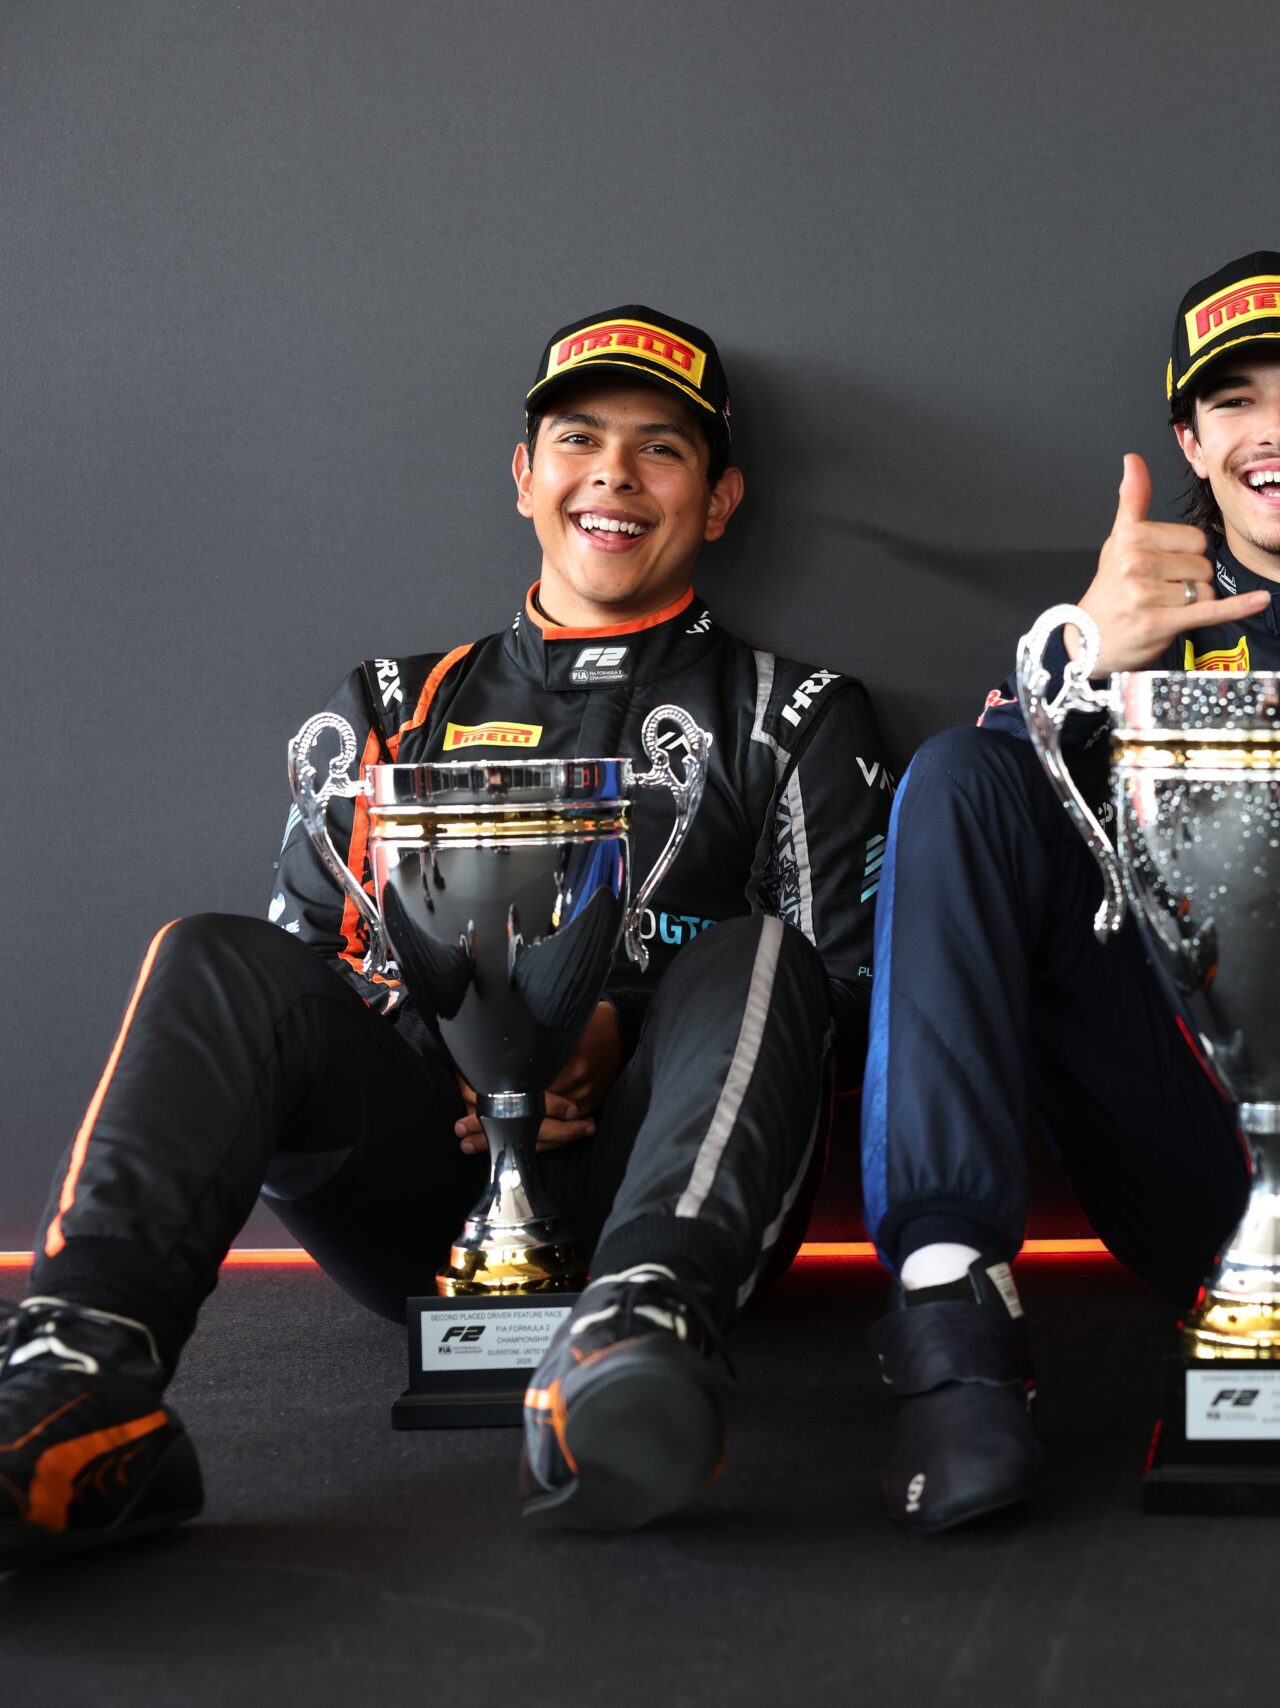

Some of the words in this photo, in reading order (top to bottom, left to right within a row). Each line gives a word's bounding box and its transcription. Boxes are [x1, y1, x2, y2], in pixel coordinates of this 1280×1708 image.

[557, 324, 695, 372] PIRELLI
[574, 647, 627, 668] F2
[572, 671, 588, 681] FIA
[781, 669, 843, 728] HRX
[452, 726, 533, 746] PIRELLI
[430, 1313, 459, 1322] SECOND
[460, 1312, 486, 1321] PLACED
[487, 1311, 512, 1320] DRIVER
[513, 1310, 543, 1319] FEATURE
[544, 1310, 562, 1318] RACE
[440, 1325, 486, 1343] F2
[495, 1324, 508, 1333] FIA
[509, 1324, 544, 1332] FORMULA
[496, 1335, 550, 1344] CHAMPIONSHIP
[438, 1345, 452, 1354] FIA
[1211, 1389, 1260, 1407] F2
